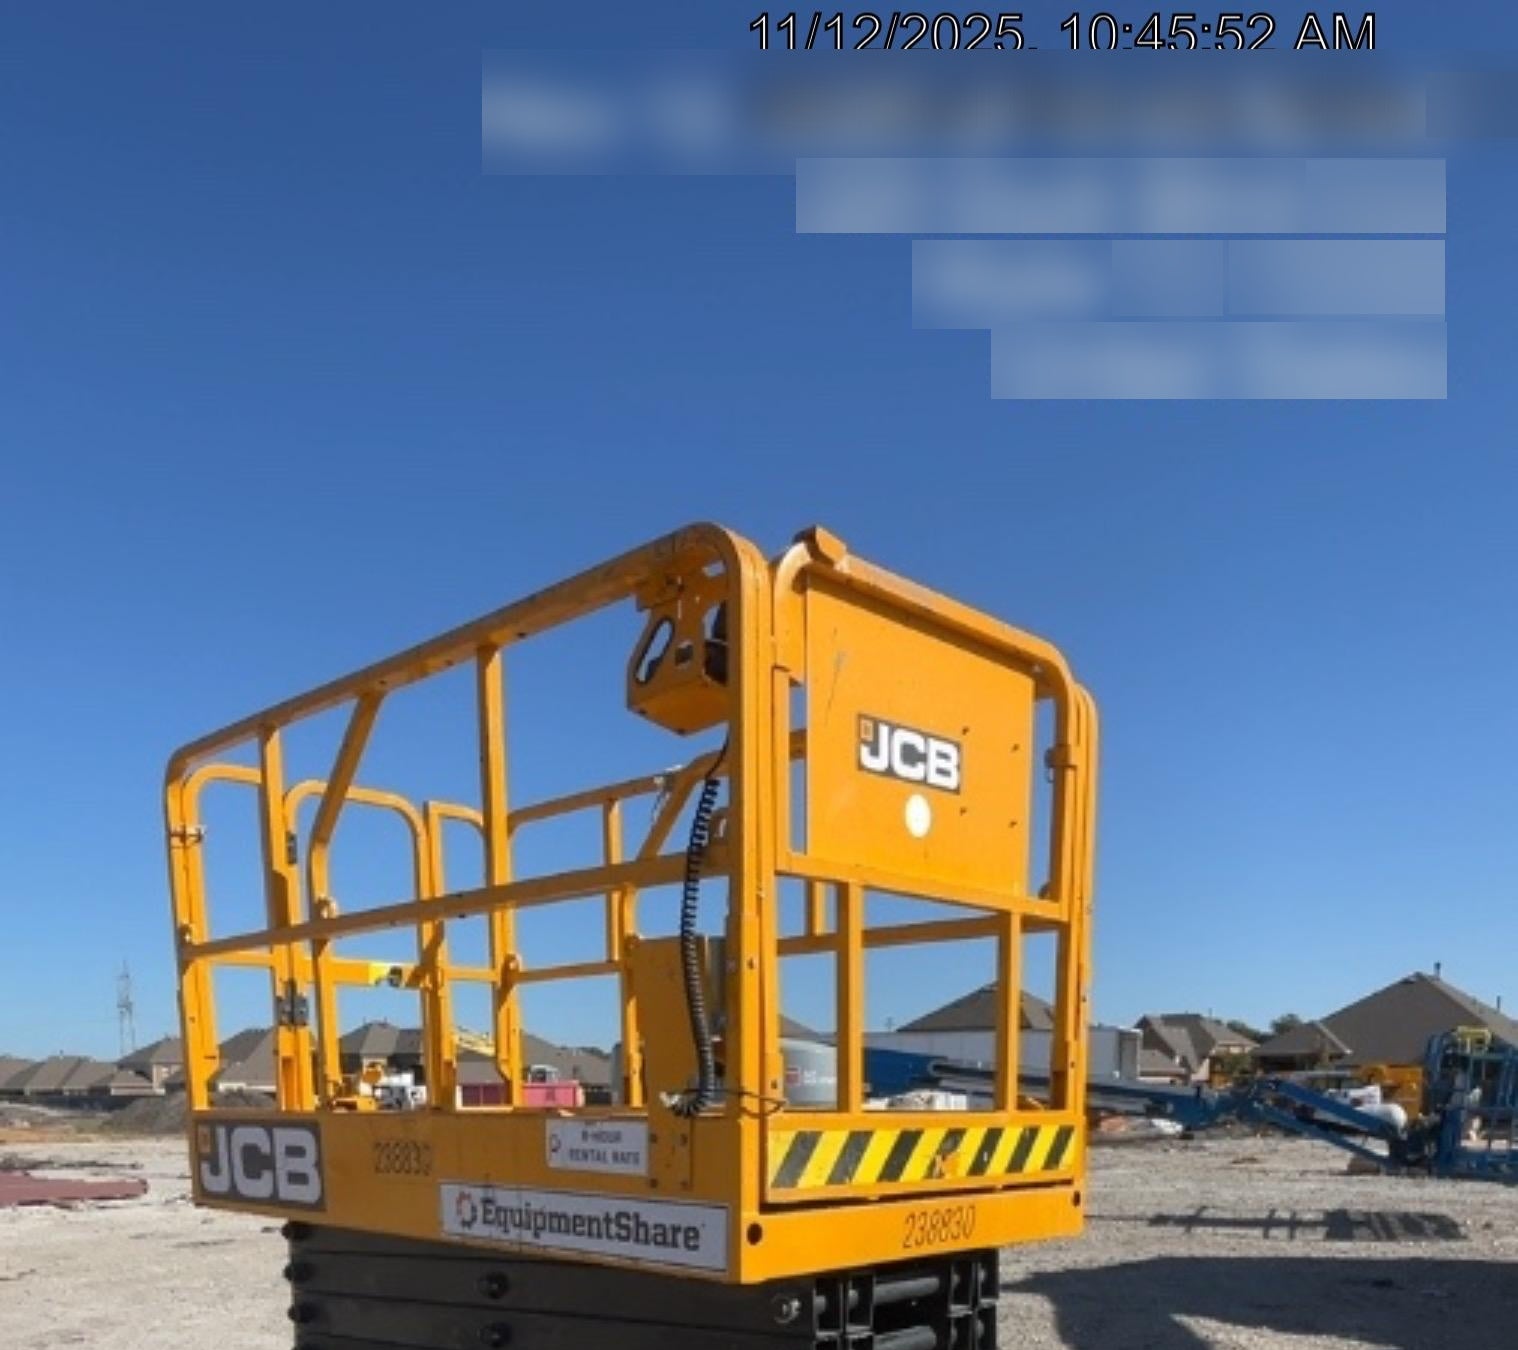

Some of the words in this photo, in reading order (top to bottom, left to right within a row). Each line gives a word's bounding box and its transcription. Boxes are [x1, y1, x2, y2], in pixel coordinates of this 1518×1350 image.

[859, 722, 960, 790] JCB
[199, 1126, 322, 1204] JCB
[480, 1196, 701, 1251] EquipmentShare
[902, 1203, 976, 1250] 238830
